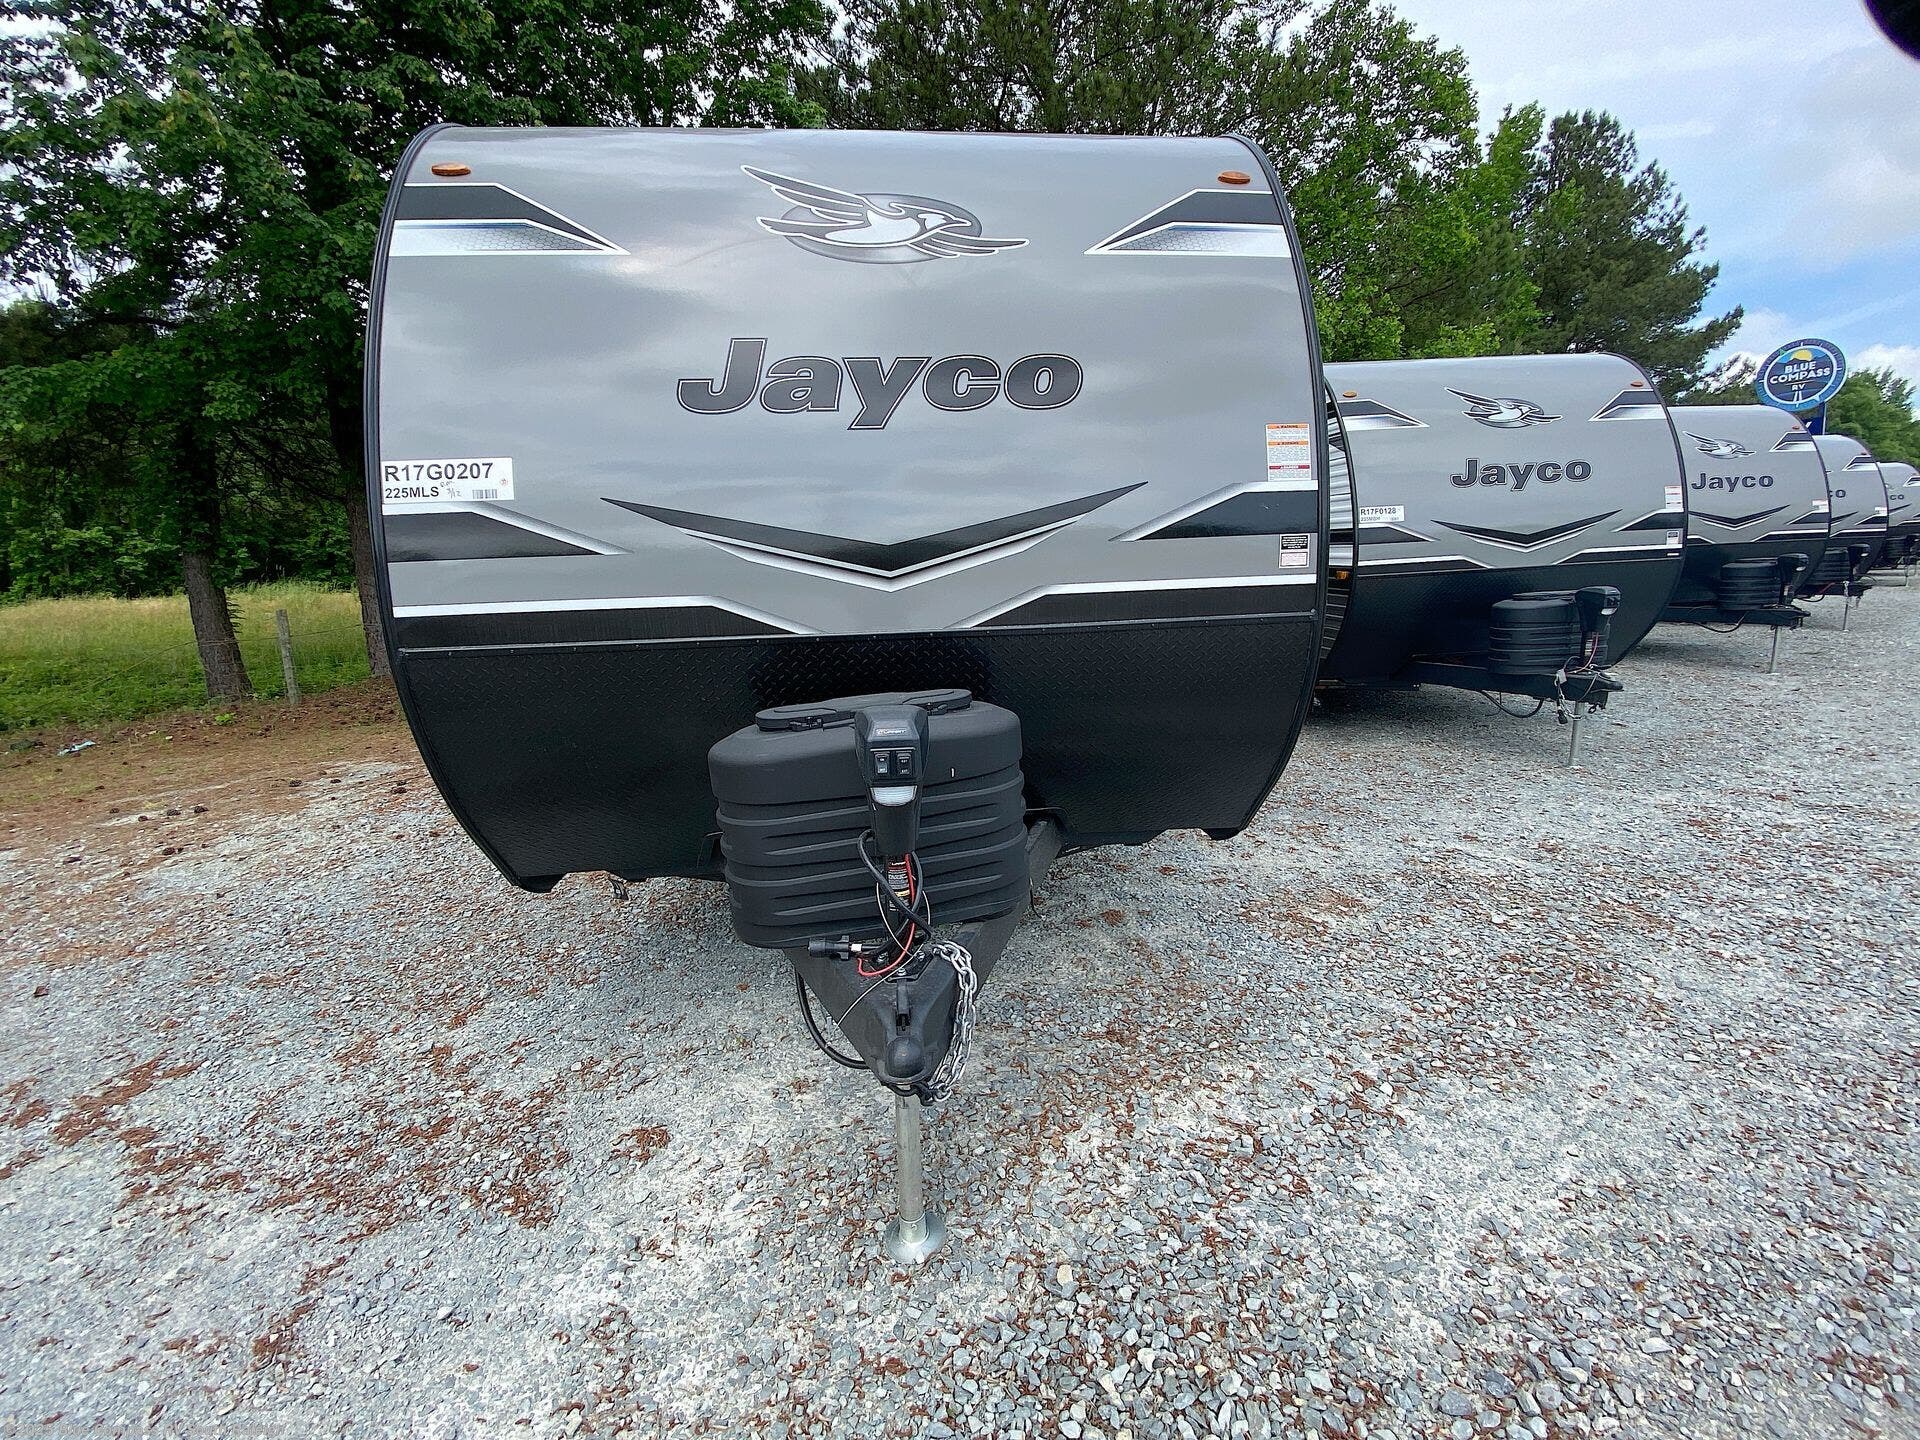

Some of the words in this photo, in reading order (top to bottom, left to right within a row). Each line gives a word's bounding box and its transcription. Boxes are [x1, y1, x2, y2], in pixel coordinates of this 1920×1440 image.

[1769, 367, 1831, 384] COMPASS
[1784, 361, 1816, 374] BLUE
[676, 337, 1084, 431] Jayco
[384, 462, 493, 482] R17G0207
[1450, 458, 1593, 492] Jayco
[385, 486, 439, 499] 225MLS
[1691, 472, 1774, 493] Jayco
